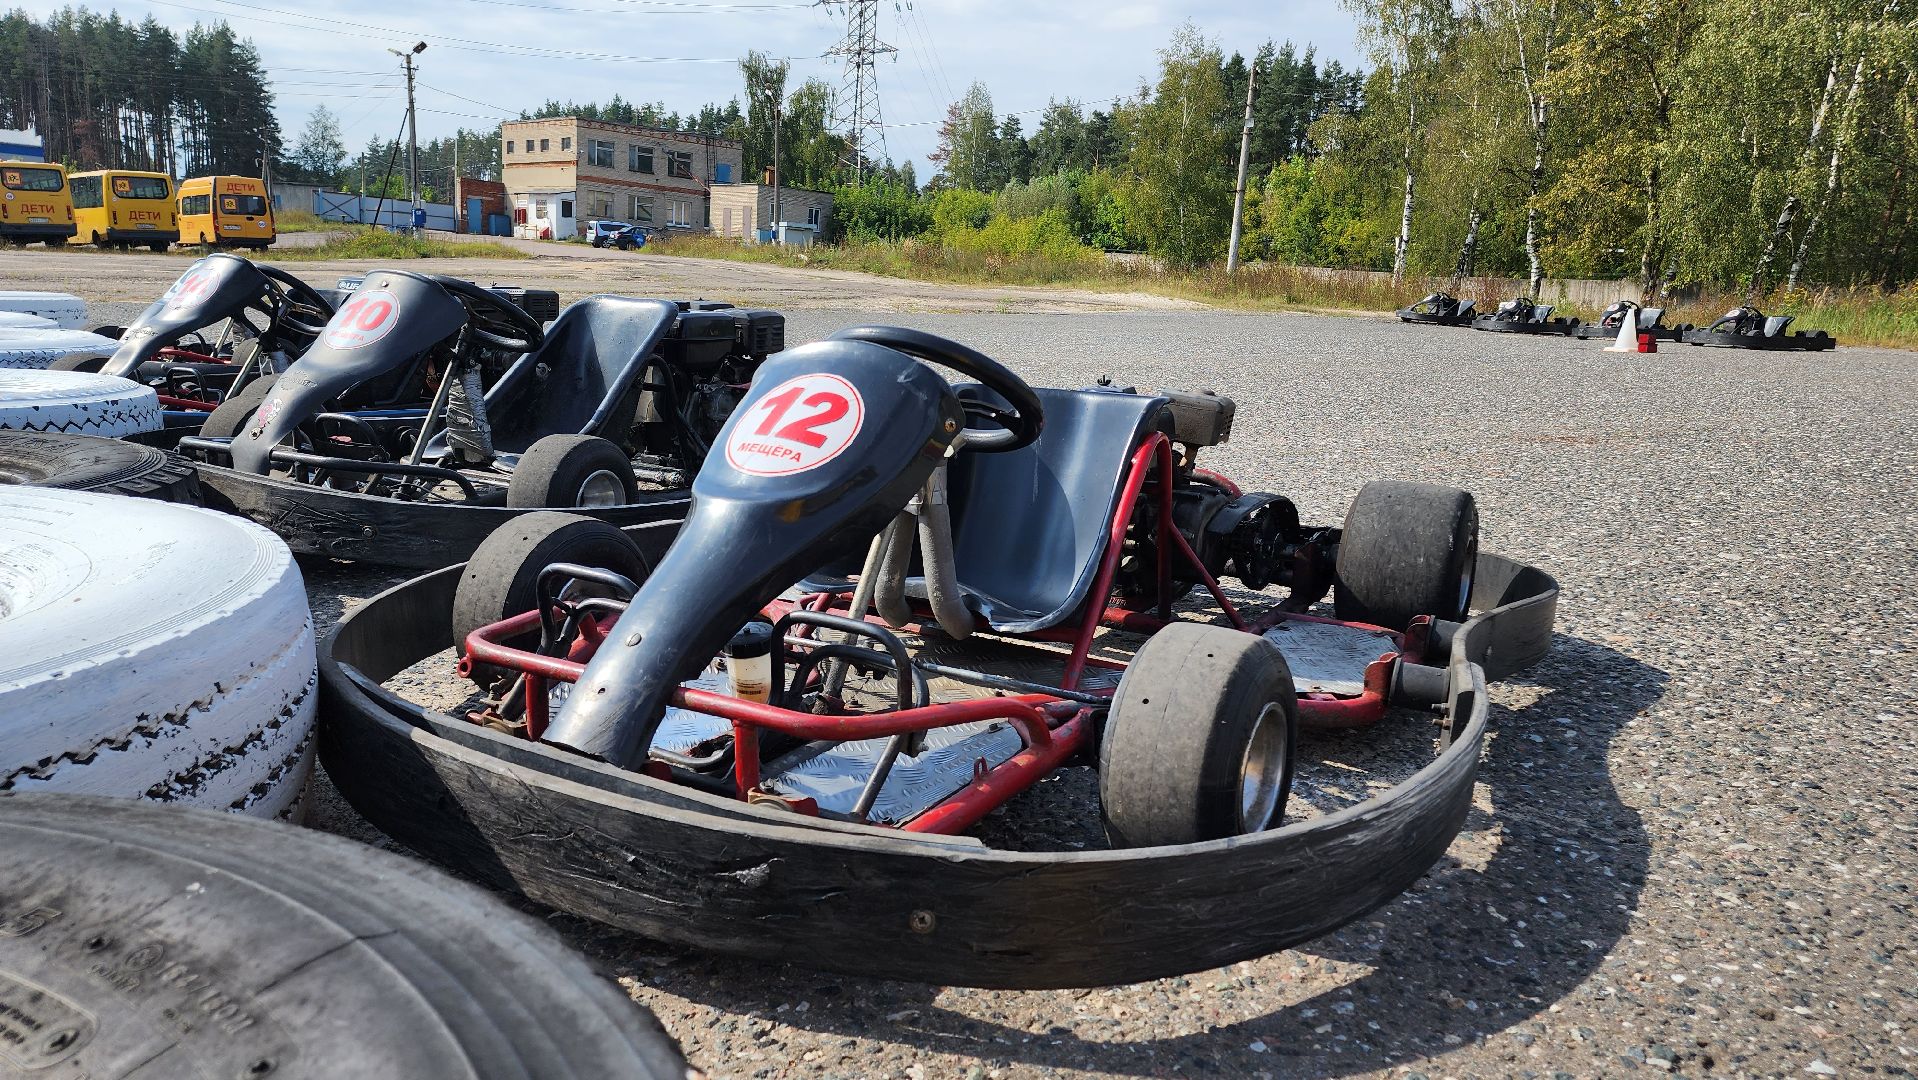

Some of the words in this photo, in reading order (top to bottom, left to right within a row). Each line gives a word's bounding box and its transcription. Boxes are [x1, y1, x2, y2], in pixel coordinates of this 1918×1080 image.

[227, 182, 256, 192] ДЕТИ
[20, 203, 55, 215] ДЕТИ
[128, 210, 161, 221] ДЕТИ
[339, 297, 393, 332] 10
[754, 387, 850, 449] 12
